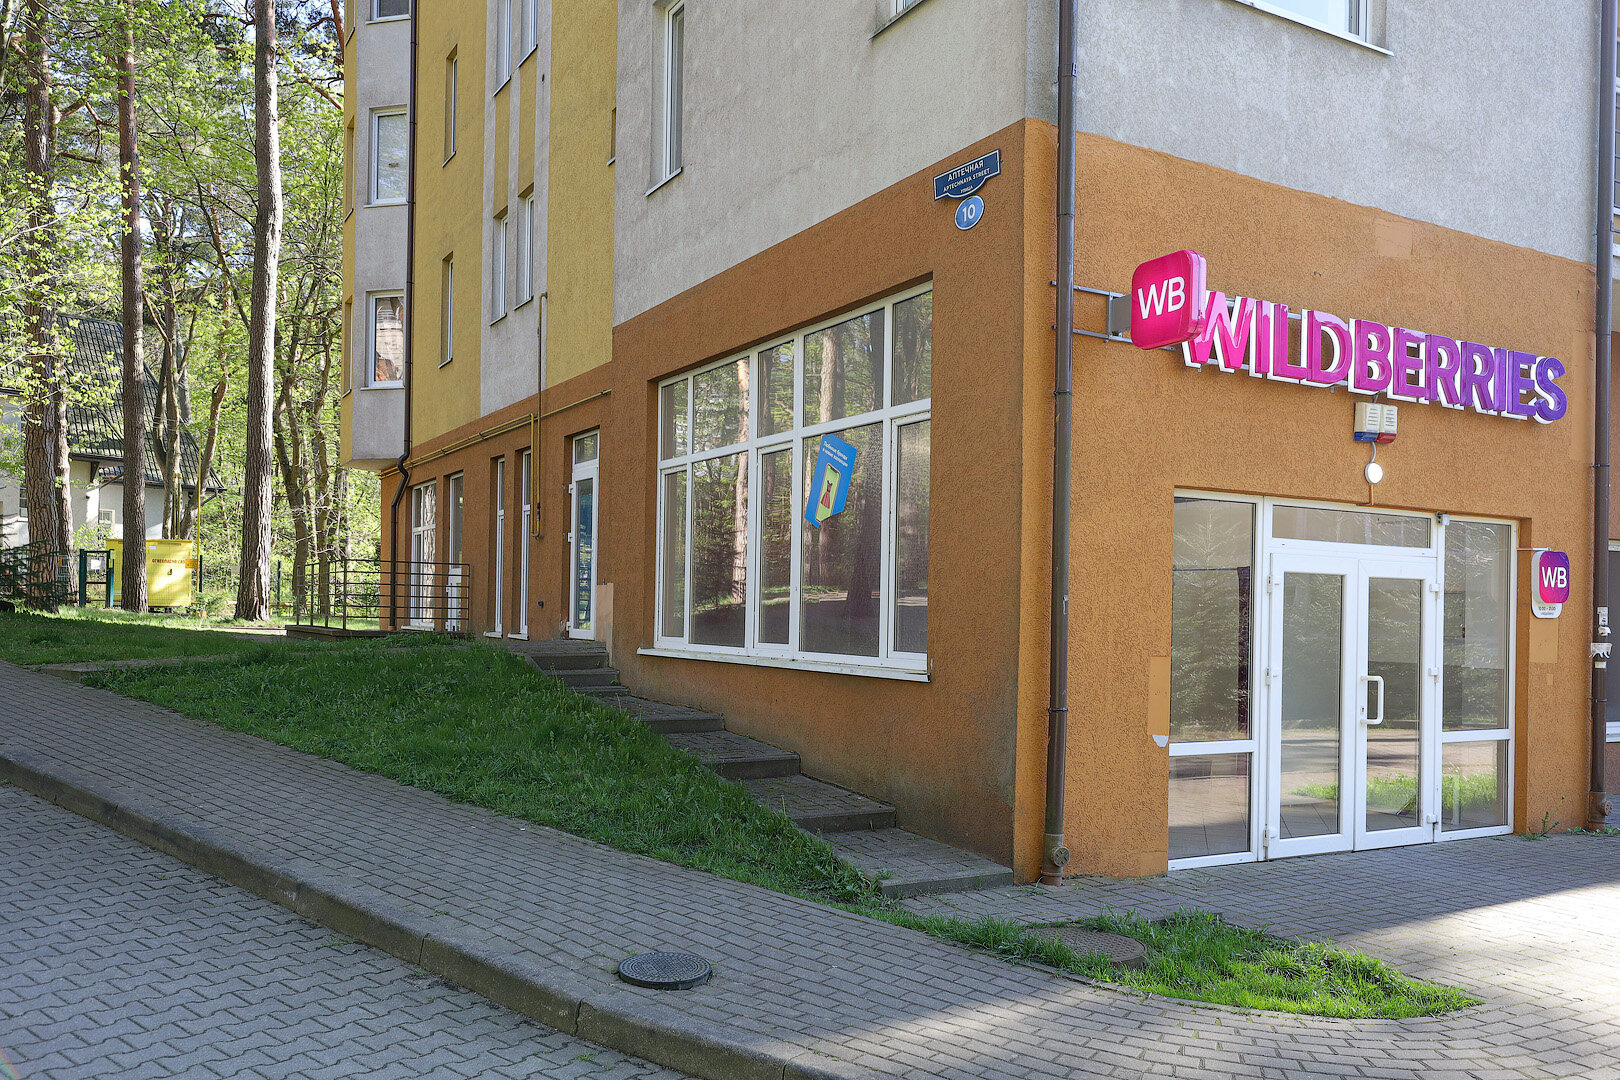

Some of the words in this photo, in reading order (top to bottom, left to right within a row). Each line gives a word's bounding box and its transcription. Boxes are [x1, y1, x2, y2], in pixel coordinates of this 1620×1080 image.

[943, 177, 972, 192] APTECHNAYA
[973, 168, 990, 180] STREET
[948, 160, 984, 181] АПТЕЧНАЯ
[962, 203, 976, 222] 10
[1137, 275, 1186, 321] WB
[1181, 290, 1568, 425] WILDBERRIES
[1542, 566, 1567, 588] WB
